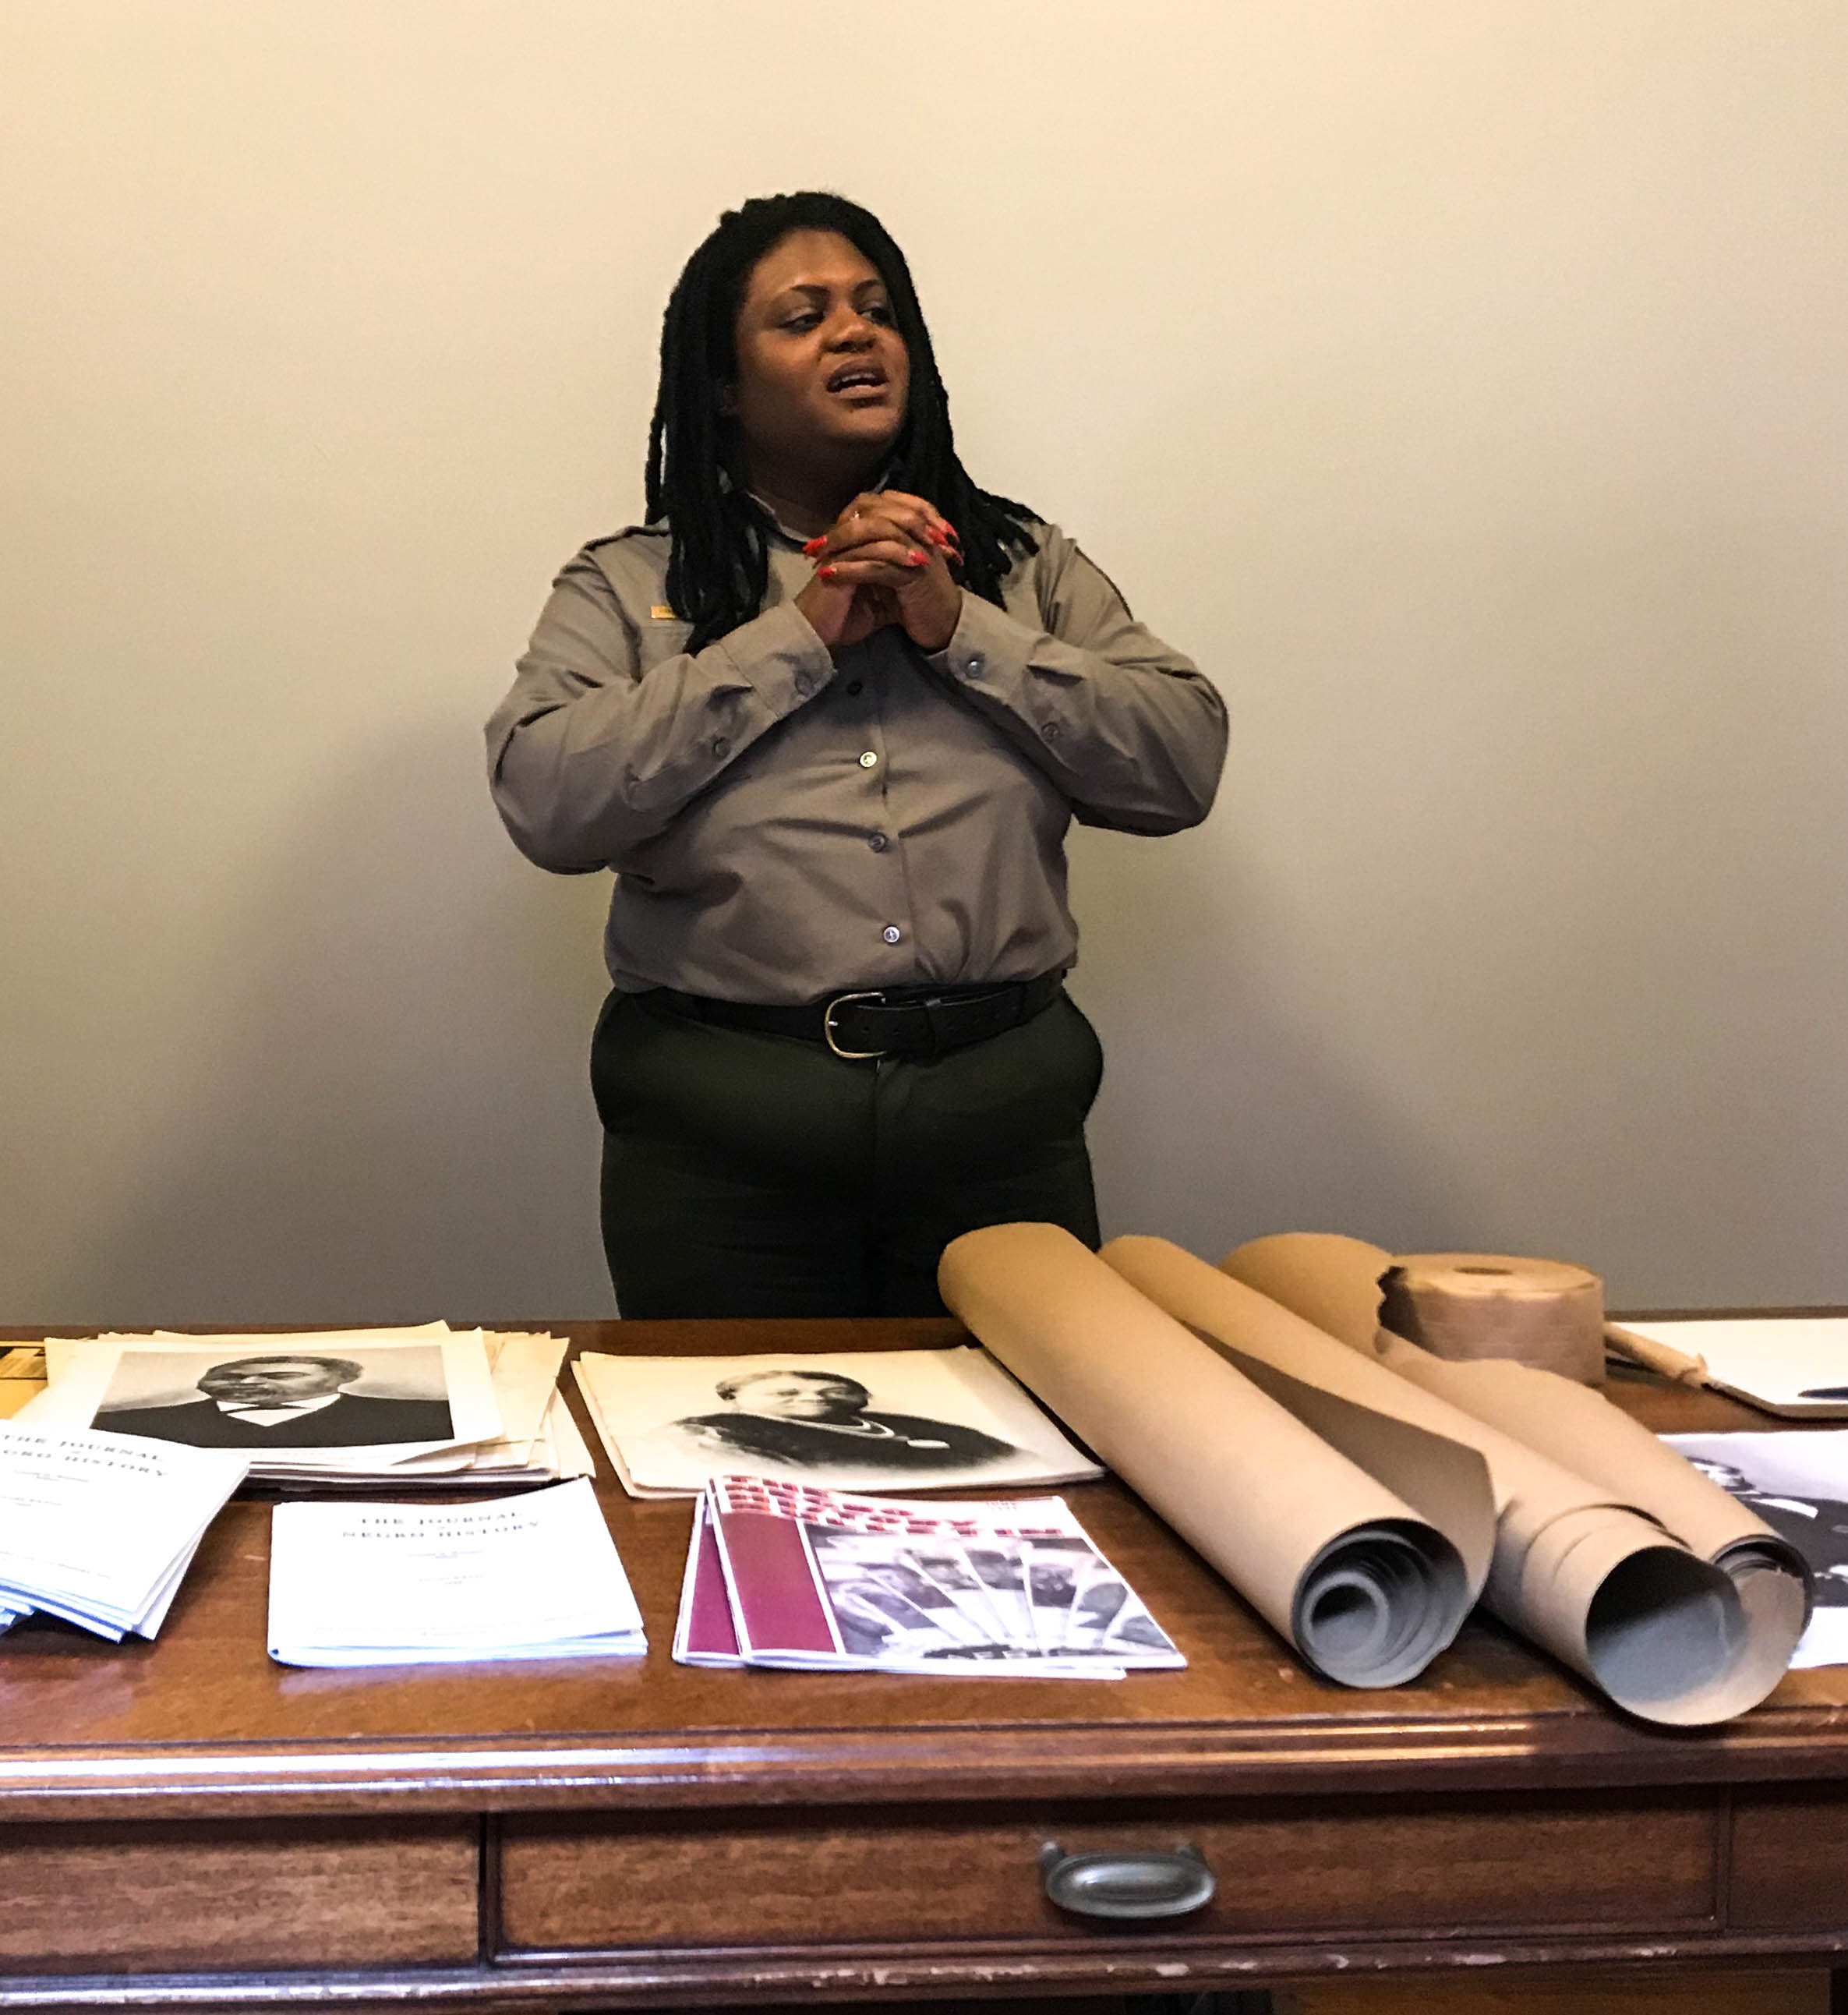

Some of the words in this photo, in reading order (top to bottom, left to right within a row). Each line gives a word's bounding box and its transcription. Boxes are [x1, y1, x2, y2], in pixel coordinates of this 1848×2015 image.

[1, 1433, 48, 1444] THE
[58, 1441, 164, 1462] JOURNAL
[62, 1455, 169, 1477] HISTORY
[418, 1511, 524, 1525] JOURNAL
[341, 1531, 425, 1540] NEGRO
[437, 1519, 539, 1537] HISTORY
